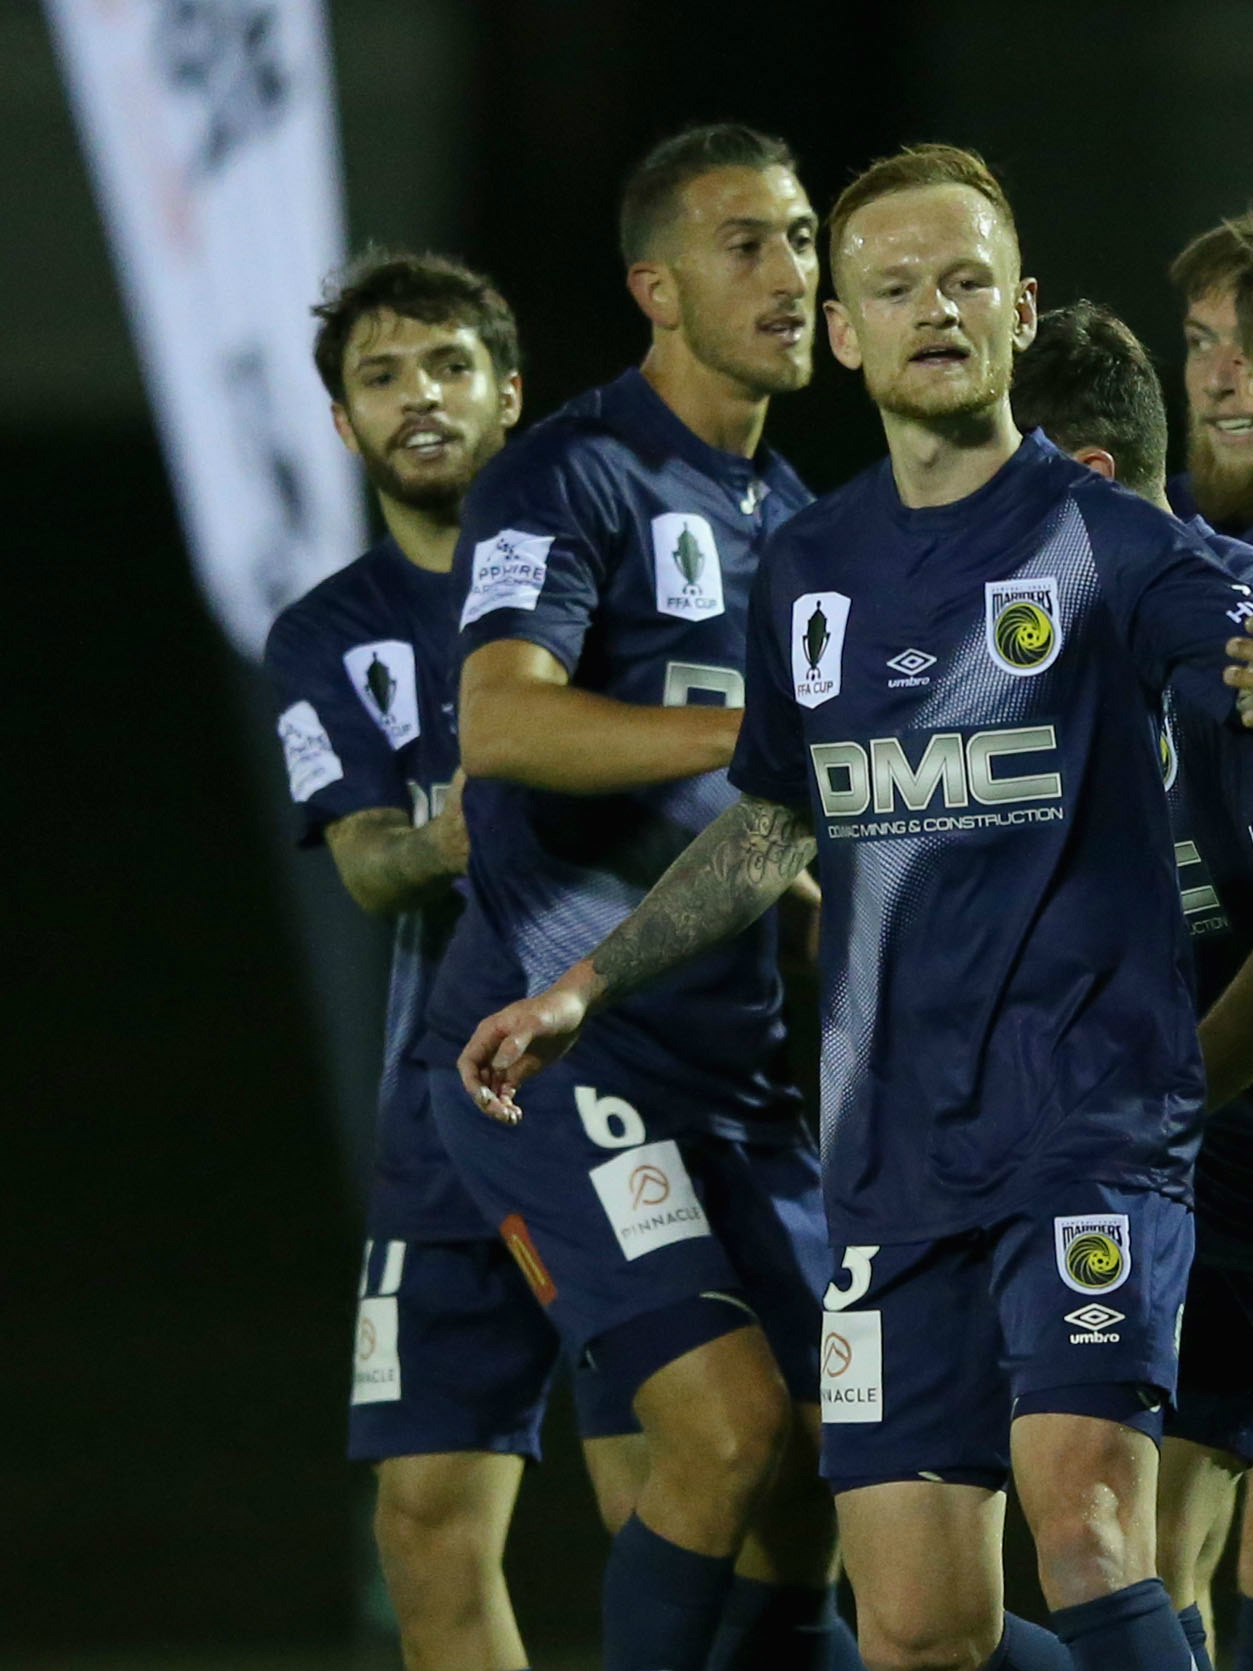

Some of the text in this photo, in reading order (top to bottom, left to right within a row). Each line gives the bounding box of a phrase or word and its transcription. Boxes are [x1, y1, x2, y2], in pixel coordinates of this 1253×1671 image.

[797, 680, 834, 697] FFA CUP
[888, 675, 931, 688] umbro
[810, 725, 1063, 818] DMC
[908, 819, 922, 833] &
[923, 807, 1064, 833] CONSTRUCTION
[574, 1085, 646, 1149] 6
[620, 1205, 701, 1240] PINNACLE
[1069, 1330, 1121, 1345] umbro
